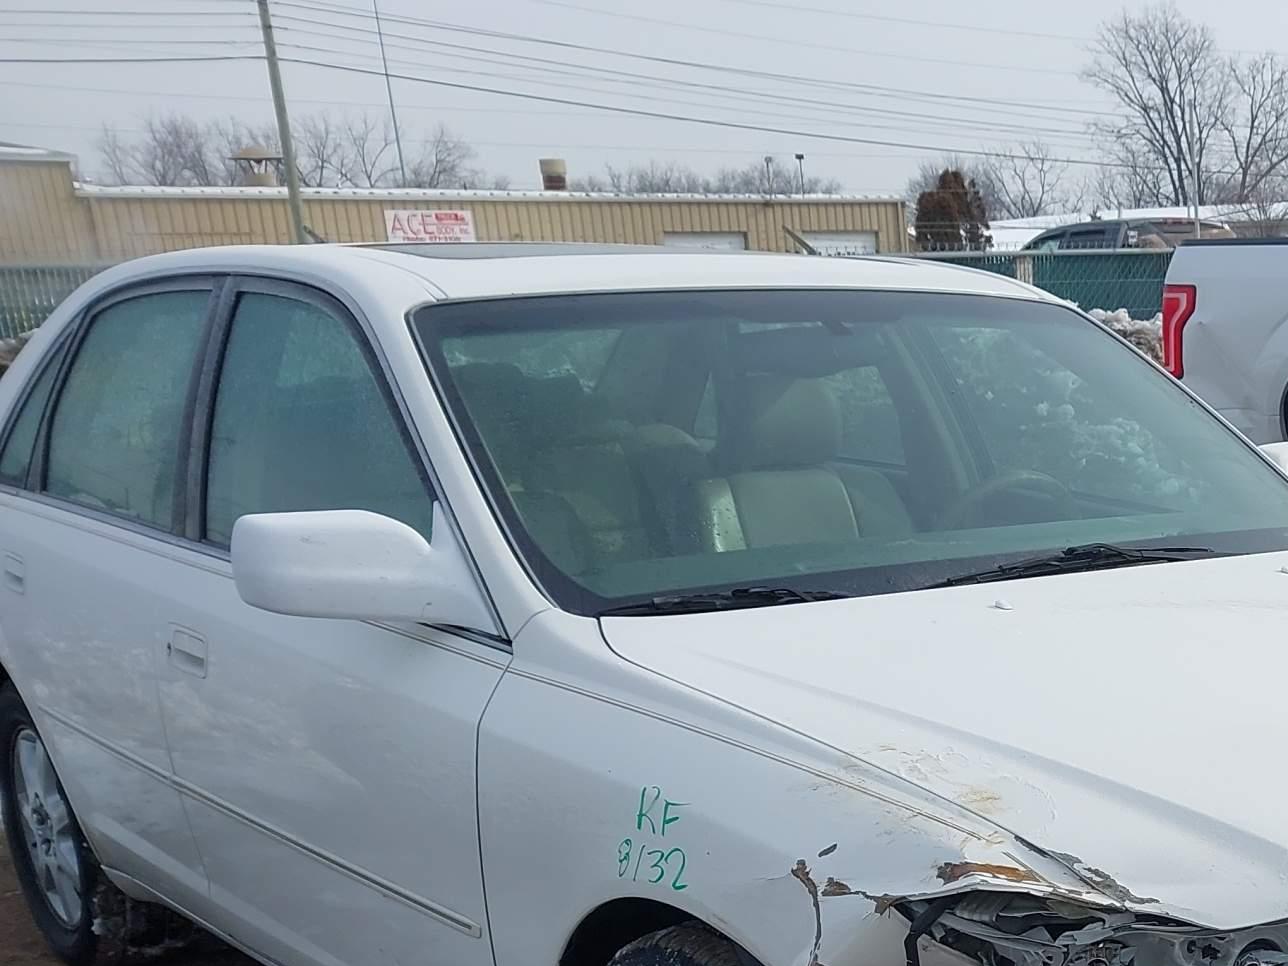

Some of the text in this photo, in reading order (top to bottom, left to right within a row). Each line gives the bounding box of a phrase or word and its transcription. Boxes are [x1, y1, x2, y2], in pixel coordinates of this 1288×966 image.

[391, 212, 434, 236] ACE
[636, 785, 692, 837] RF
[618, 838, 688, 890] 8/32
